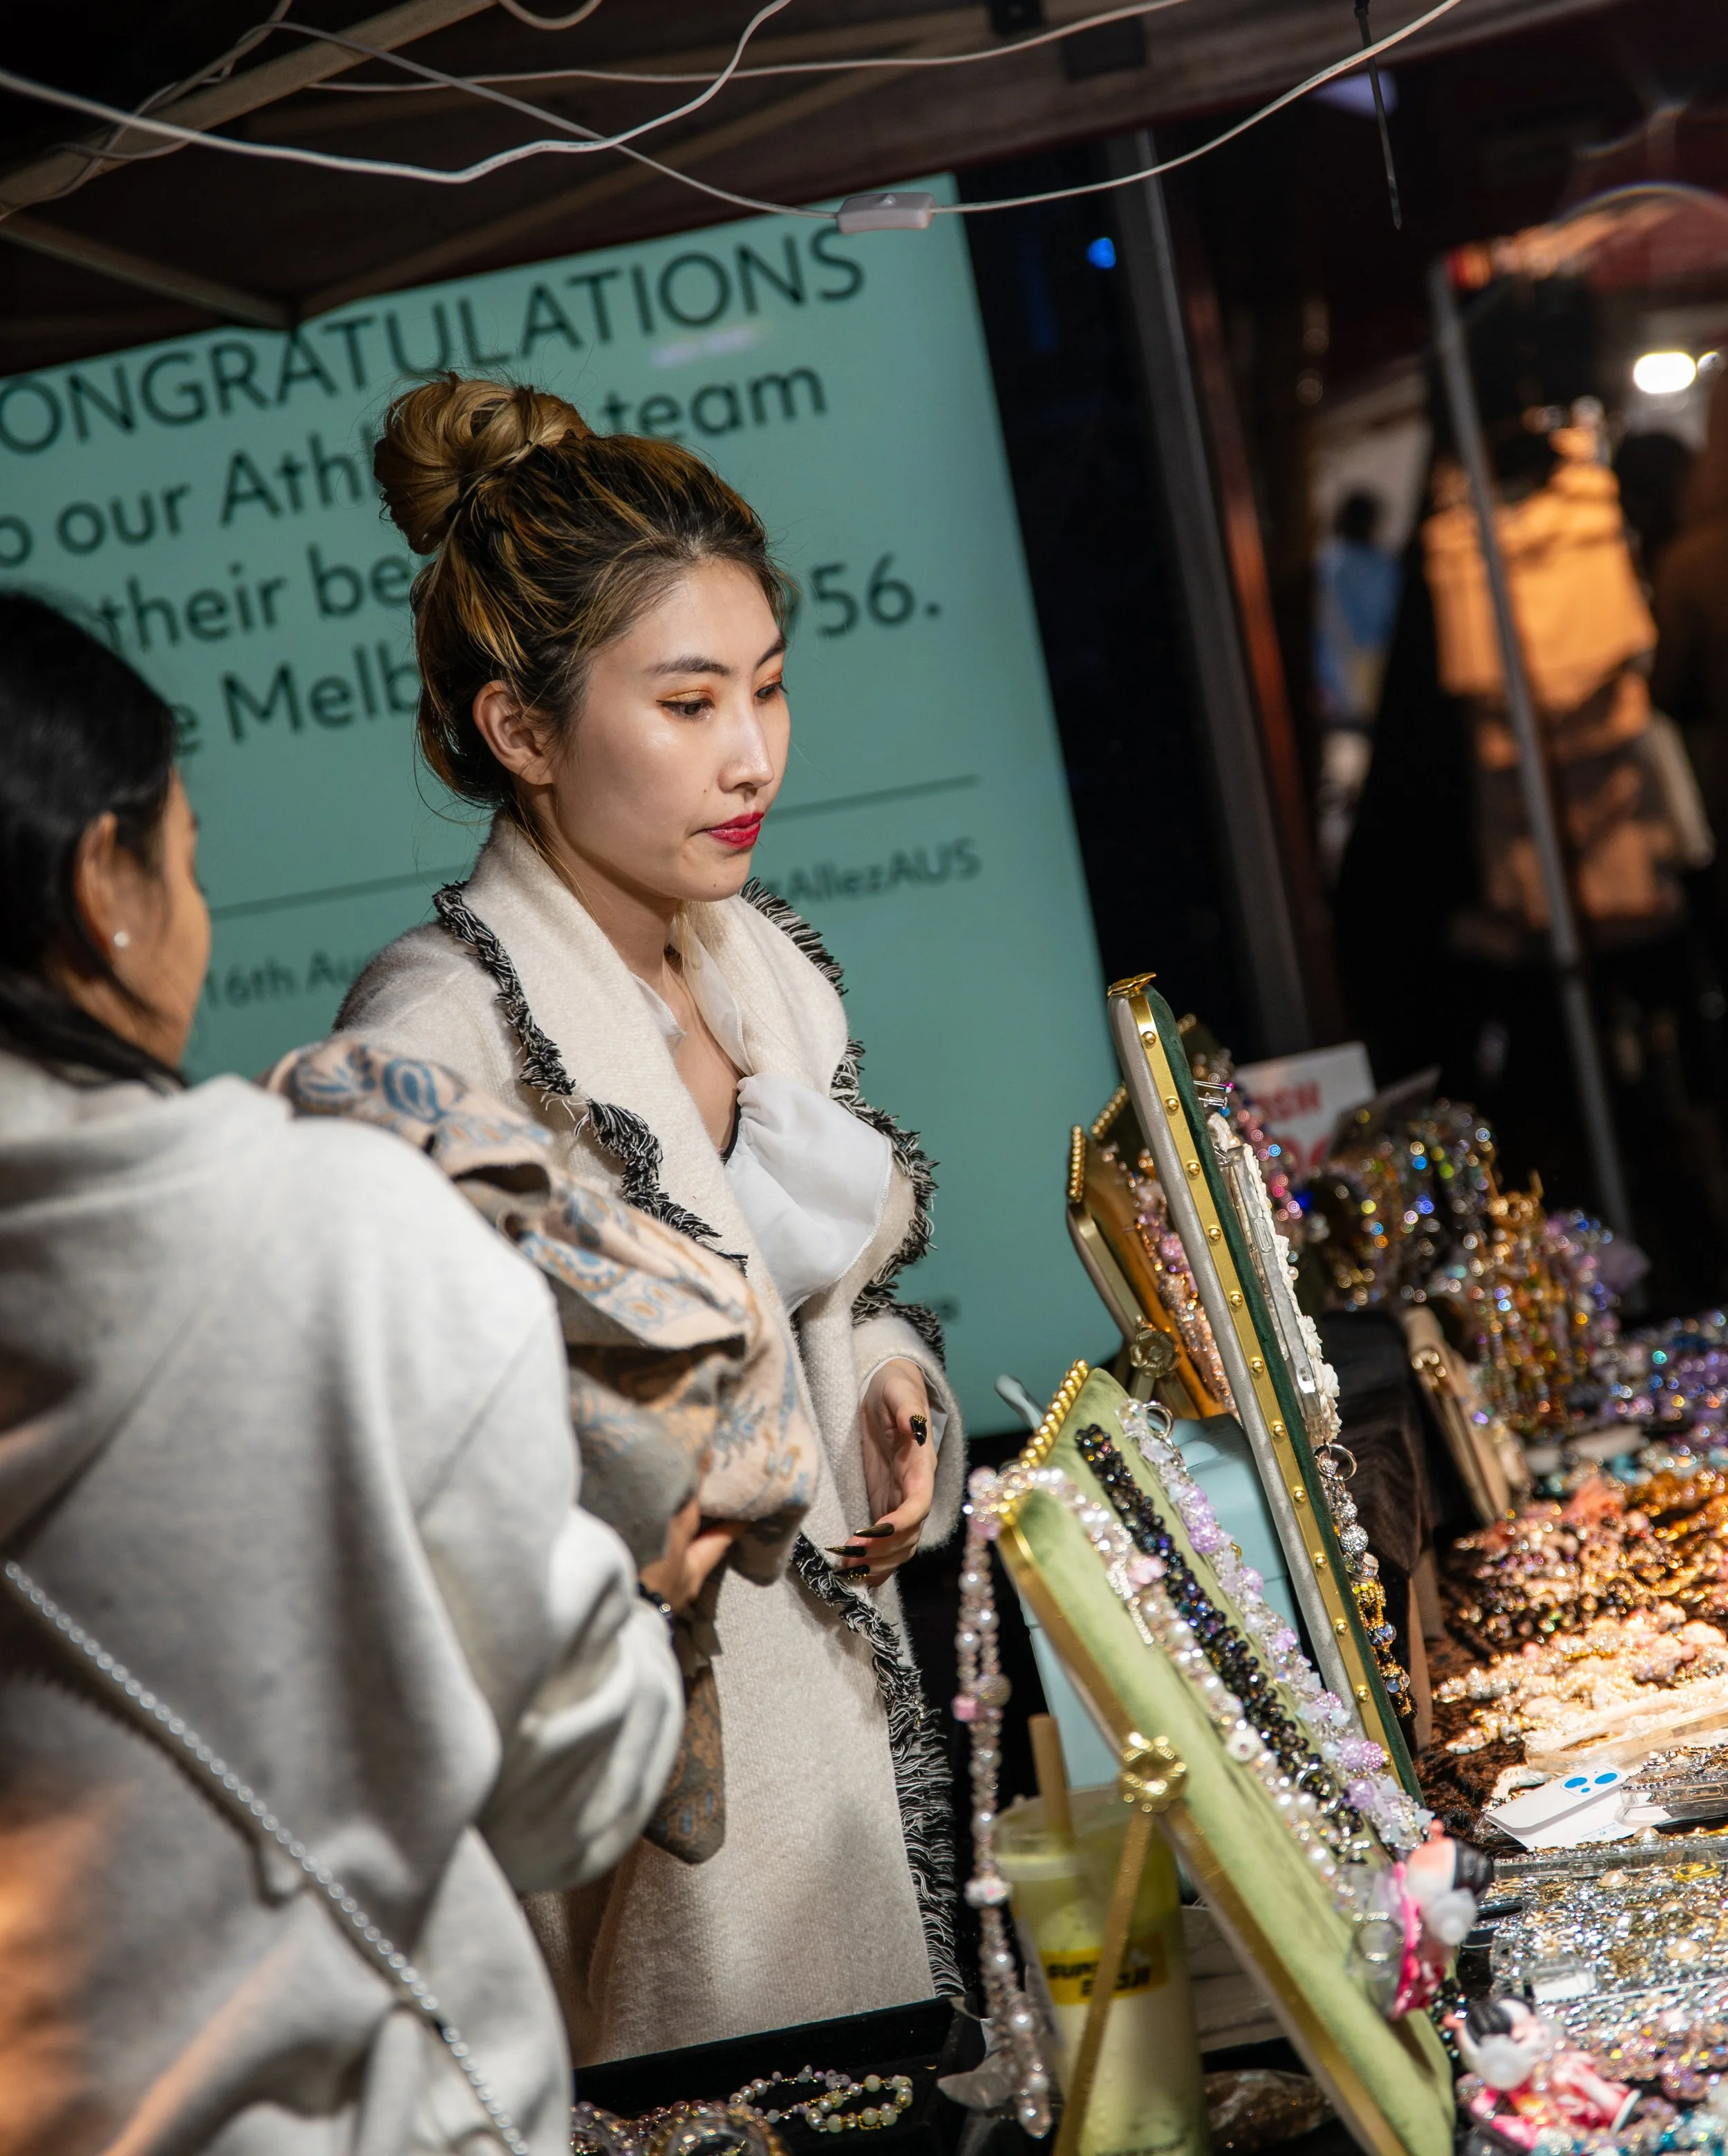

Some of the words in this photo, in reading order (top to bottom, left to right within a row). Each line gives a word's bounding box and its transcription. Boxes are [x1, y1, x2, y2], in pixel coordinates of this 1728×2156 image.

[55, 482, 191, 556] our
[599, 366, 827, 442] team
[98, 560, 286, 652] their
[306, 541, 413, 619] be
[786, 552, 942, 640] 56.
